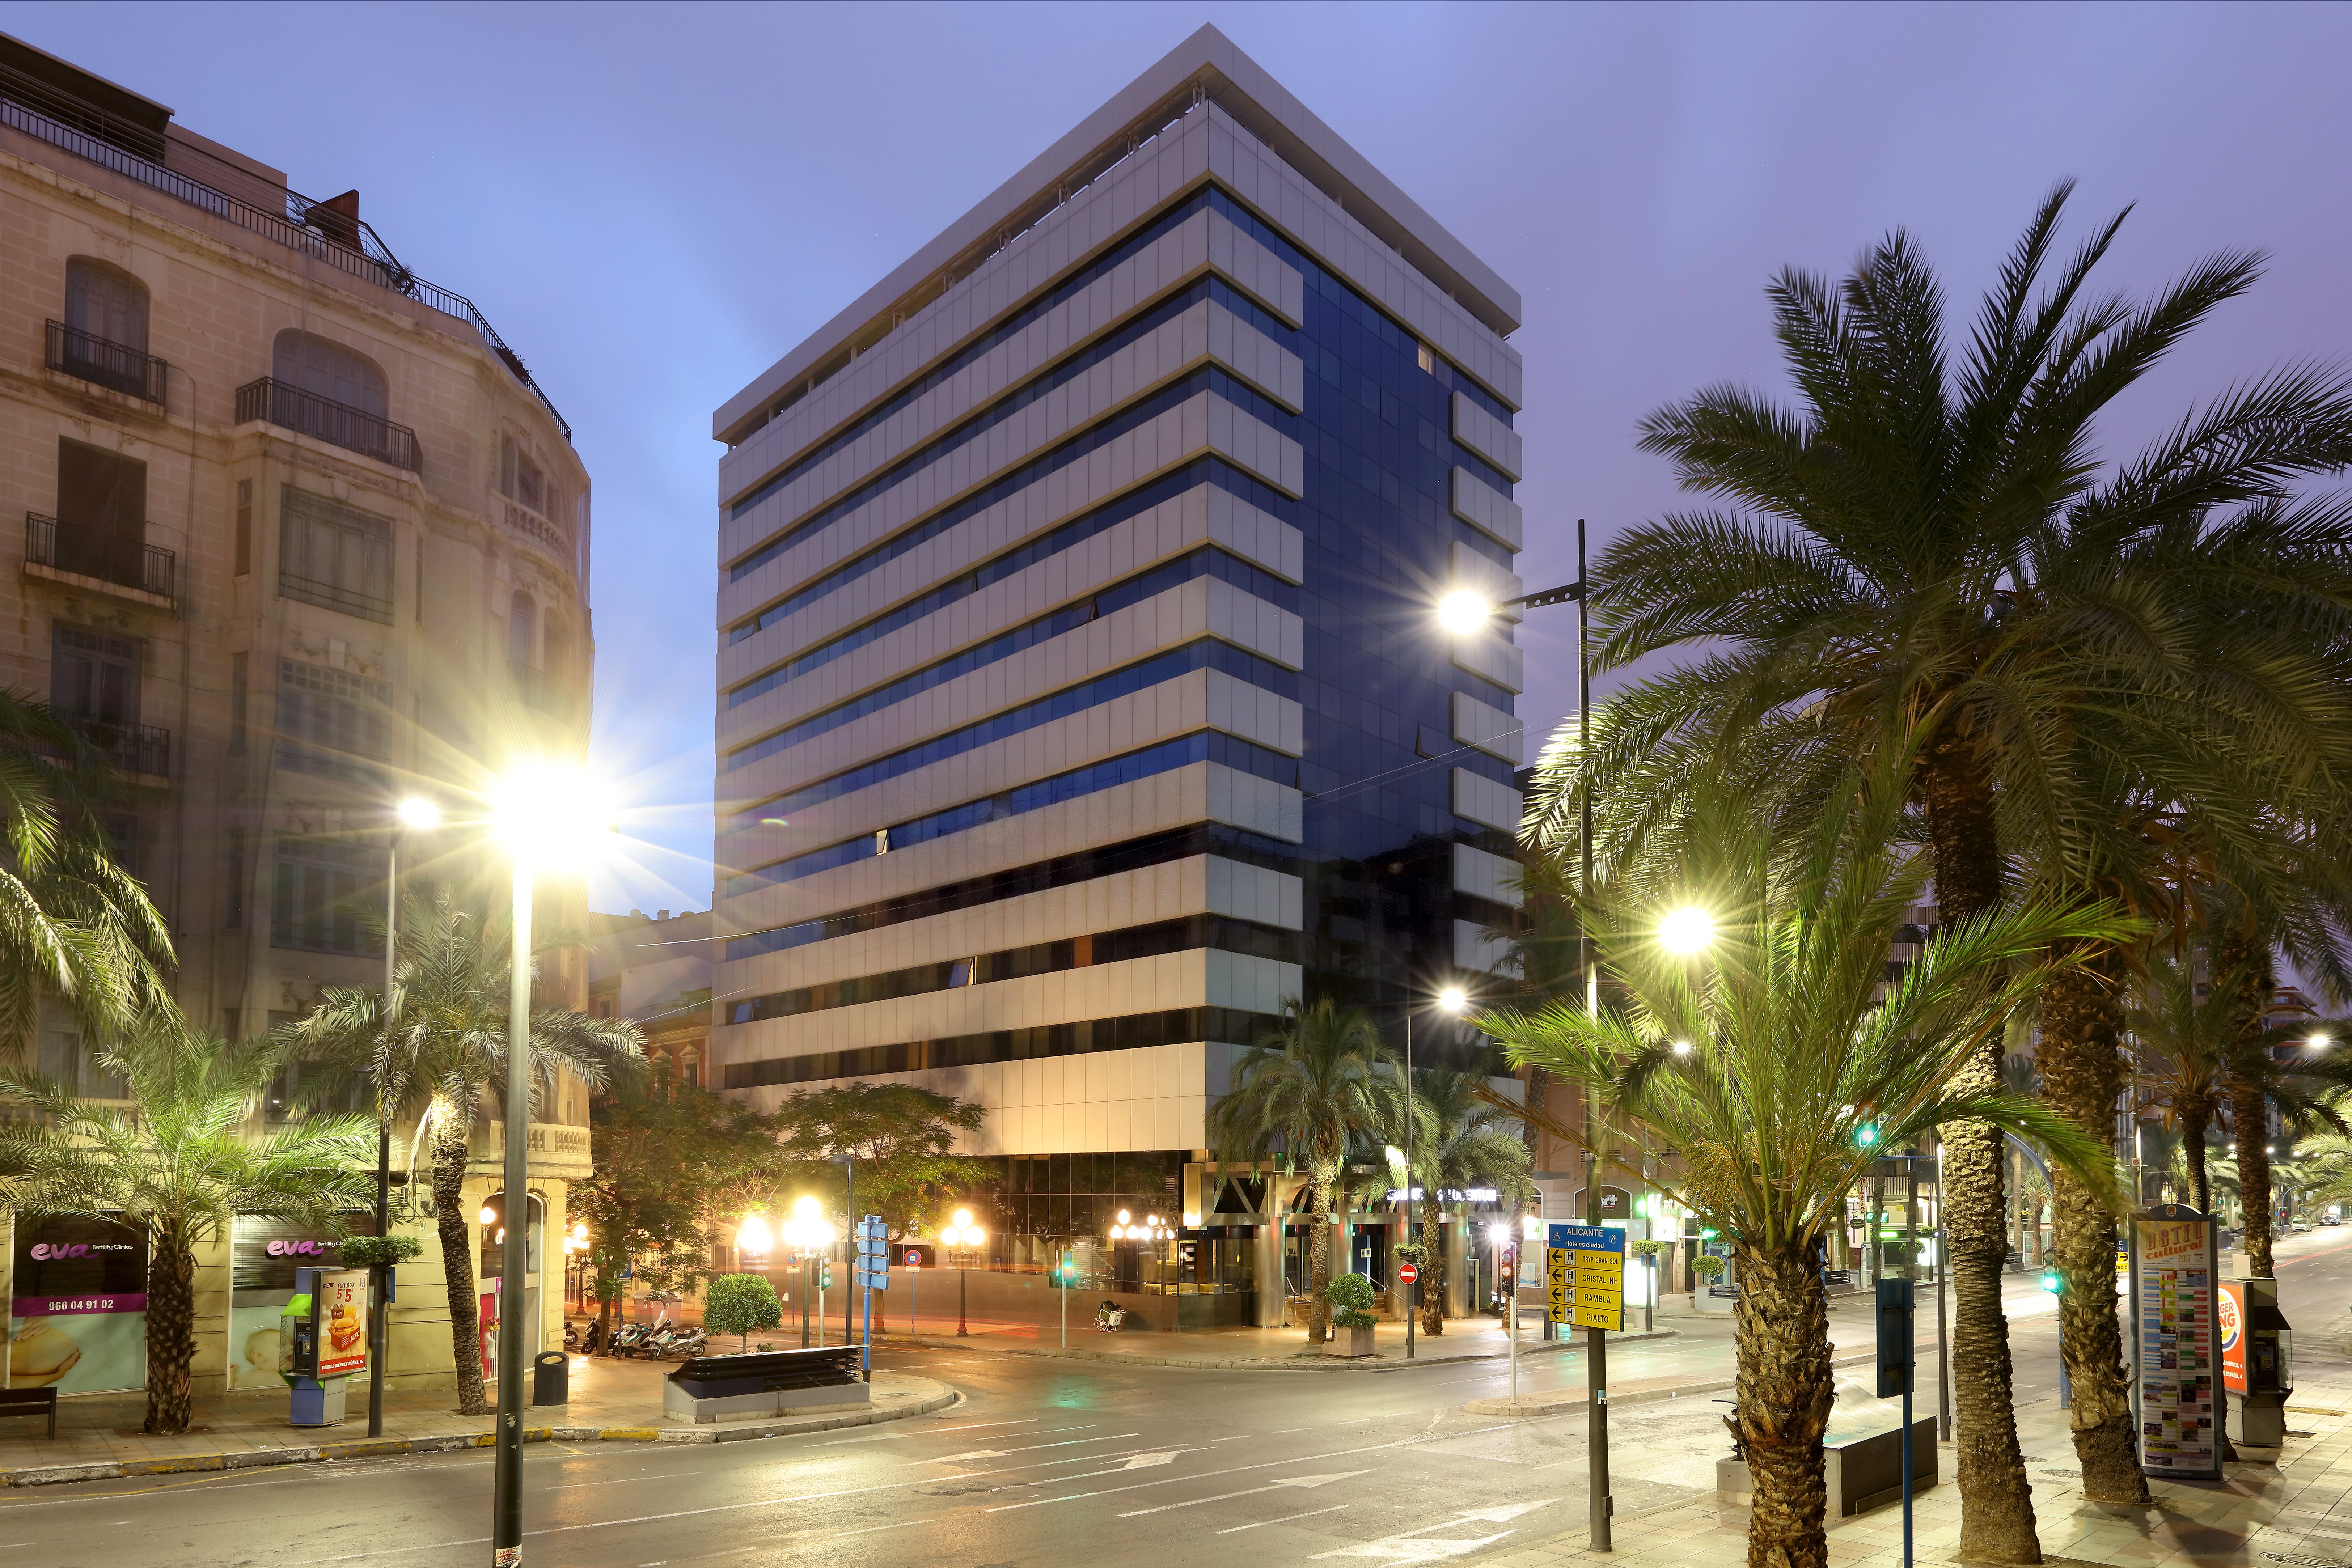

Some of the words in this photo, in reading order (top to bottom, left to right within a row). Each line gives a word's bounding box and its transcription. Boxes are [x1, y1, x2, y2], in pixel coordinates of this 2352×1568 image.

[1566, 1228, 1603, 1237] ALICANTE
[31, 1243, 99, 1260] eva
[267, 1240, 324, 1255] eva
[2146, 1239, 2203, 1260] cultural
[1583, 1275, 1606, 1283] CRISTAL
[337, 1289, 342, 1299] 5
[1585, 1294, 1611, 1304] RAMBLA
[48, 1302, 67, 1310] 966
[71, 1301, 83, 1309] 04
[86, 1300, 97, 1309] 91
[101, 1299, 113, 1308] 02
[1587, 1313, 1609, 1323] RIALTO
[350, 1330, 360, 1343] KFC
[2226, 1371, 2239, 1380] ESPAÑA,
